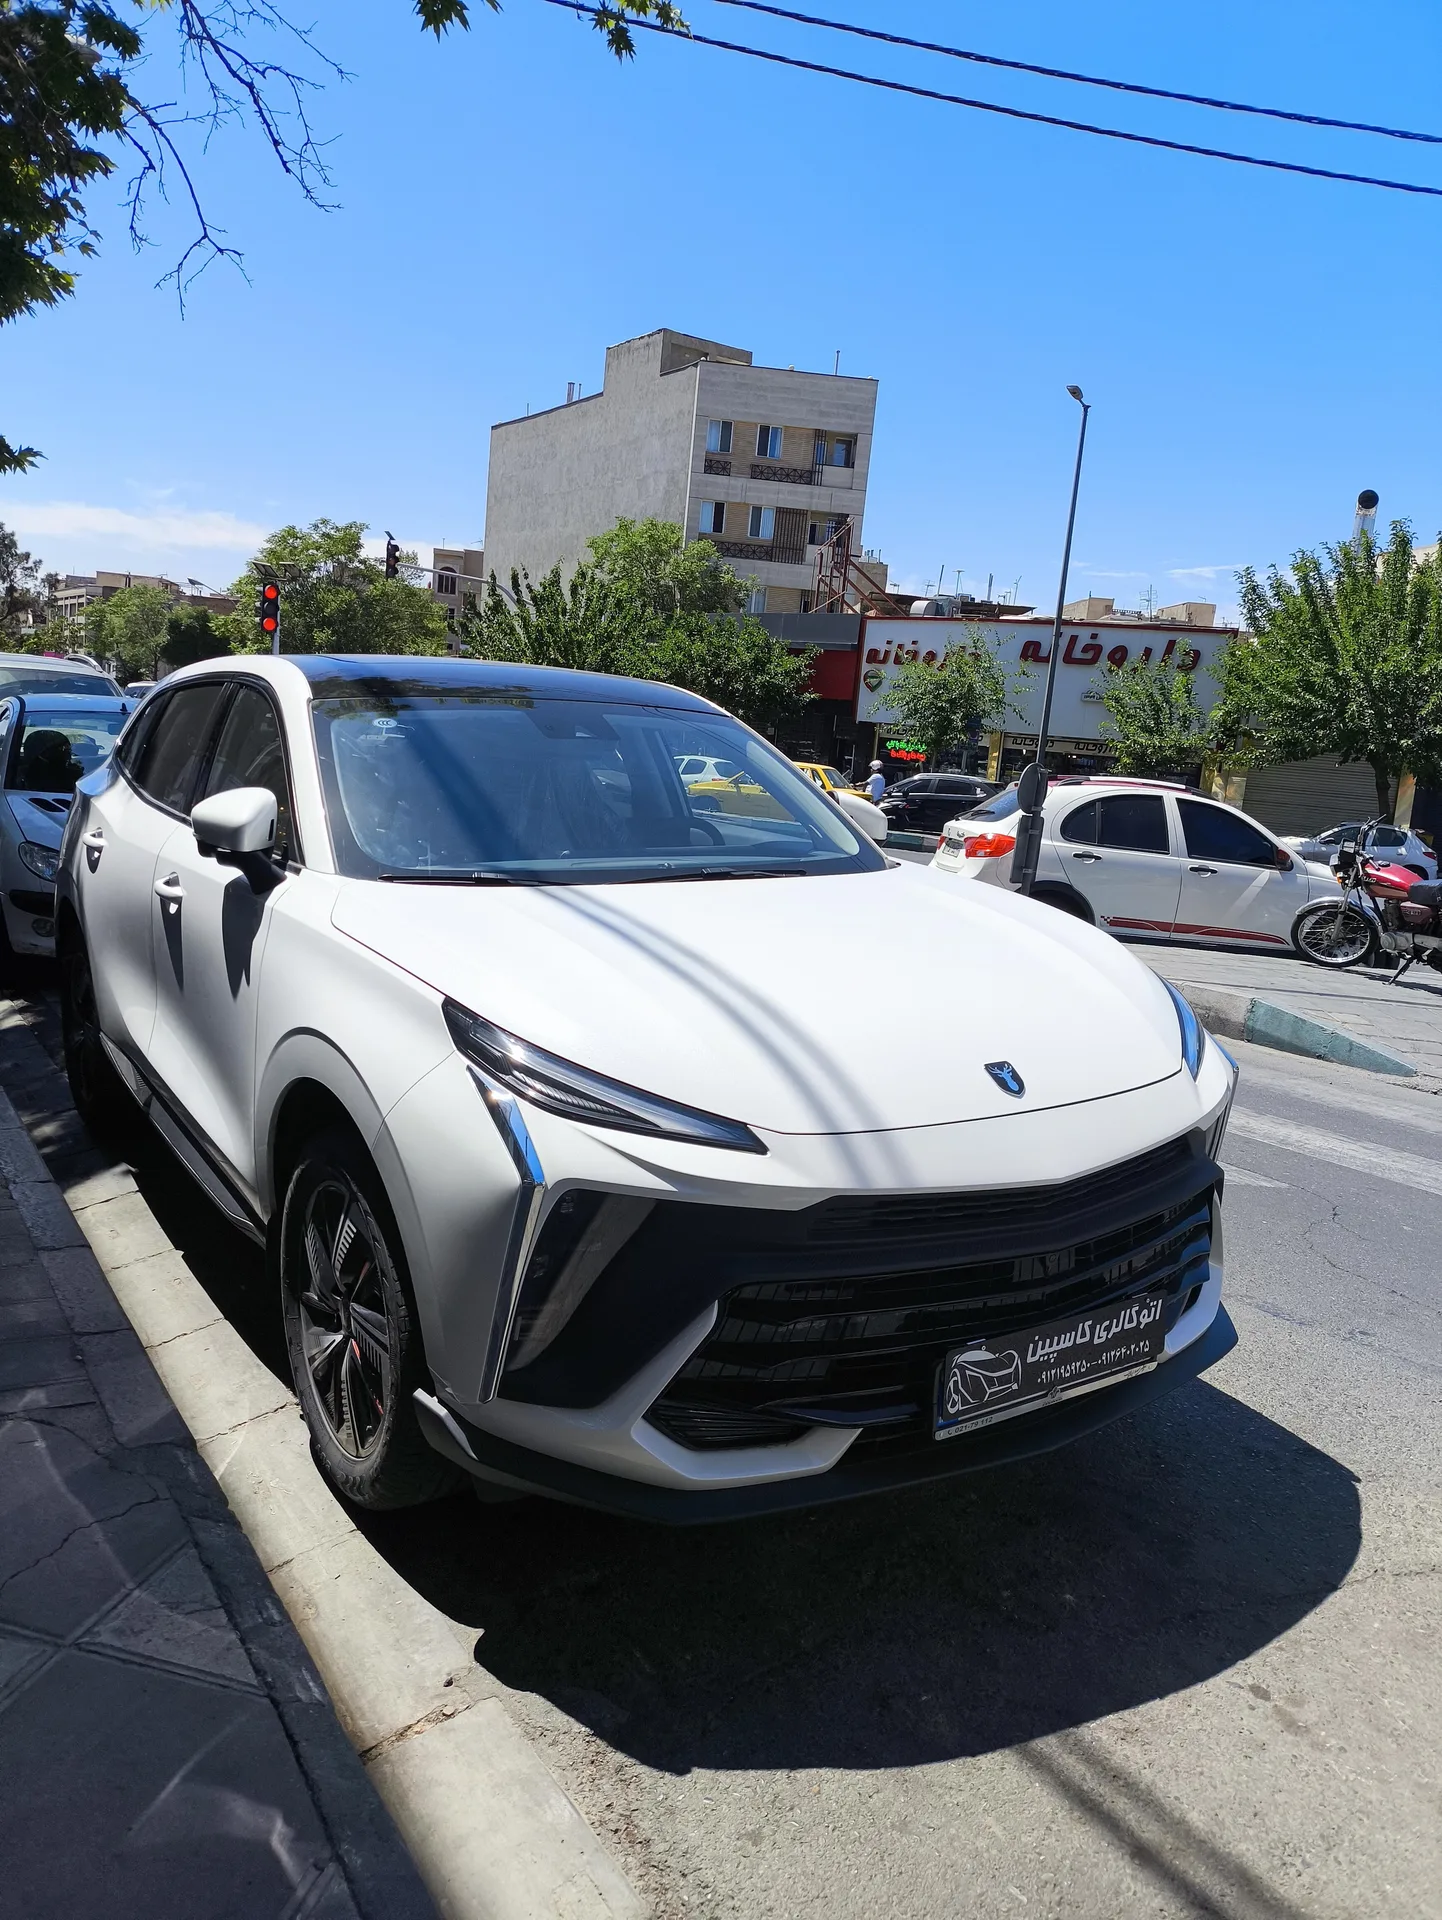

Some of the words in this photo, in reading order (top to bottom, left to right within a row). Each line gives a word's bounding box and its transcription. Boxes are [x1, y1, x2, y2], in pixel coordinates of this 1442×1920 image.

[865, 640, 981, 671] روخانه
[1074, 742, 1119, 754] اروخانه
[1026, 1320, 1092, 1363] کاسپین
